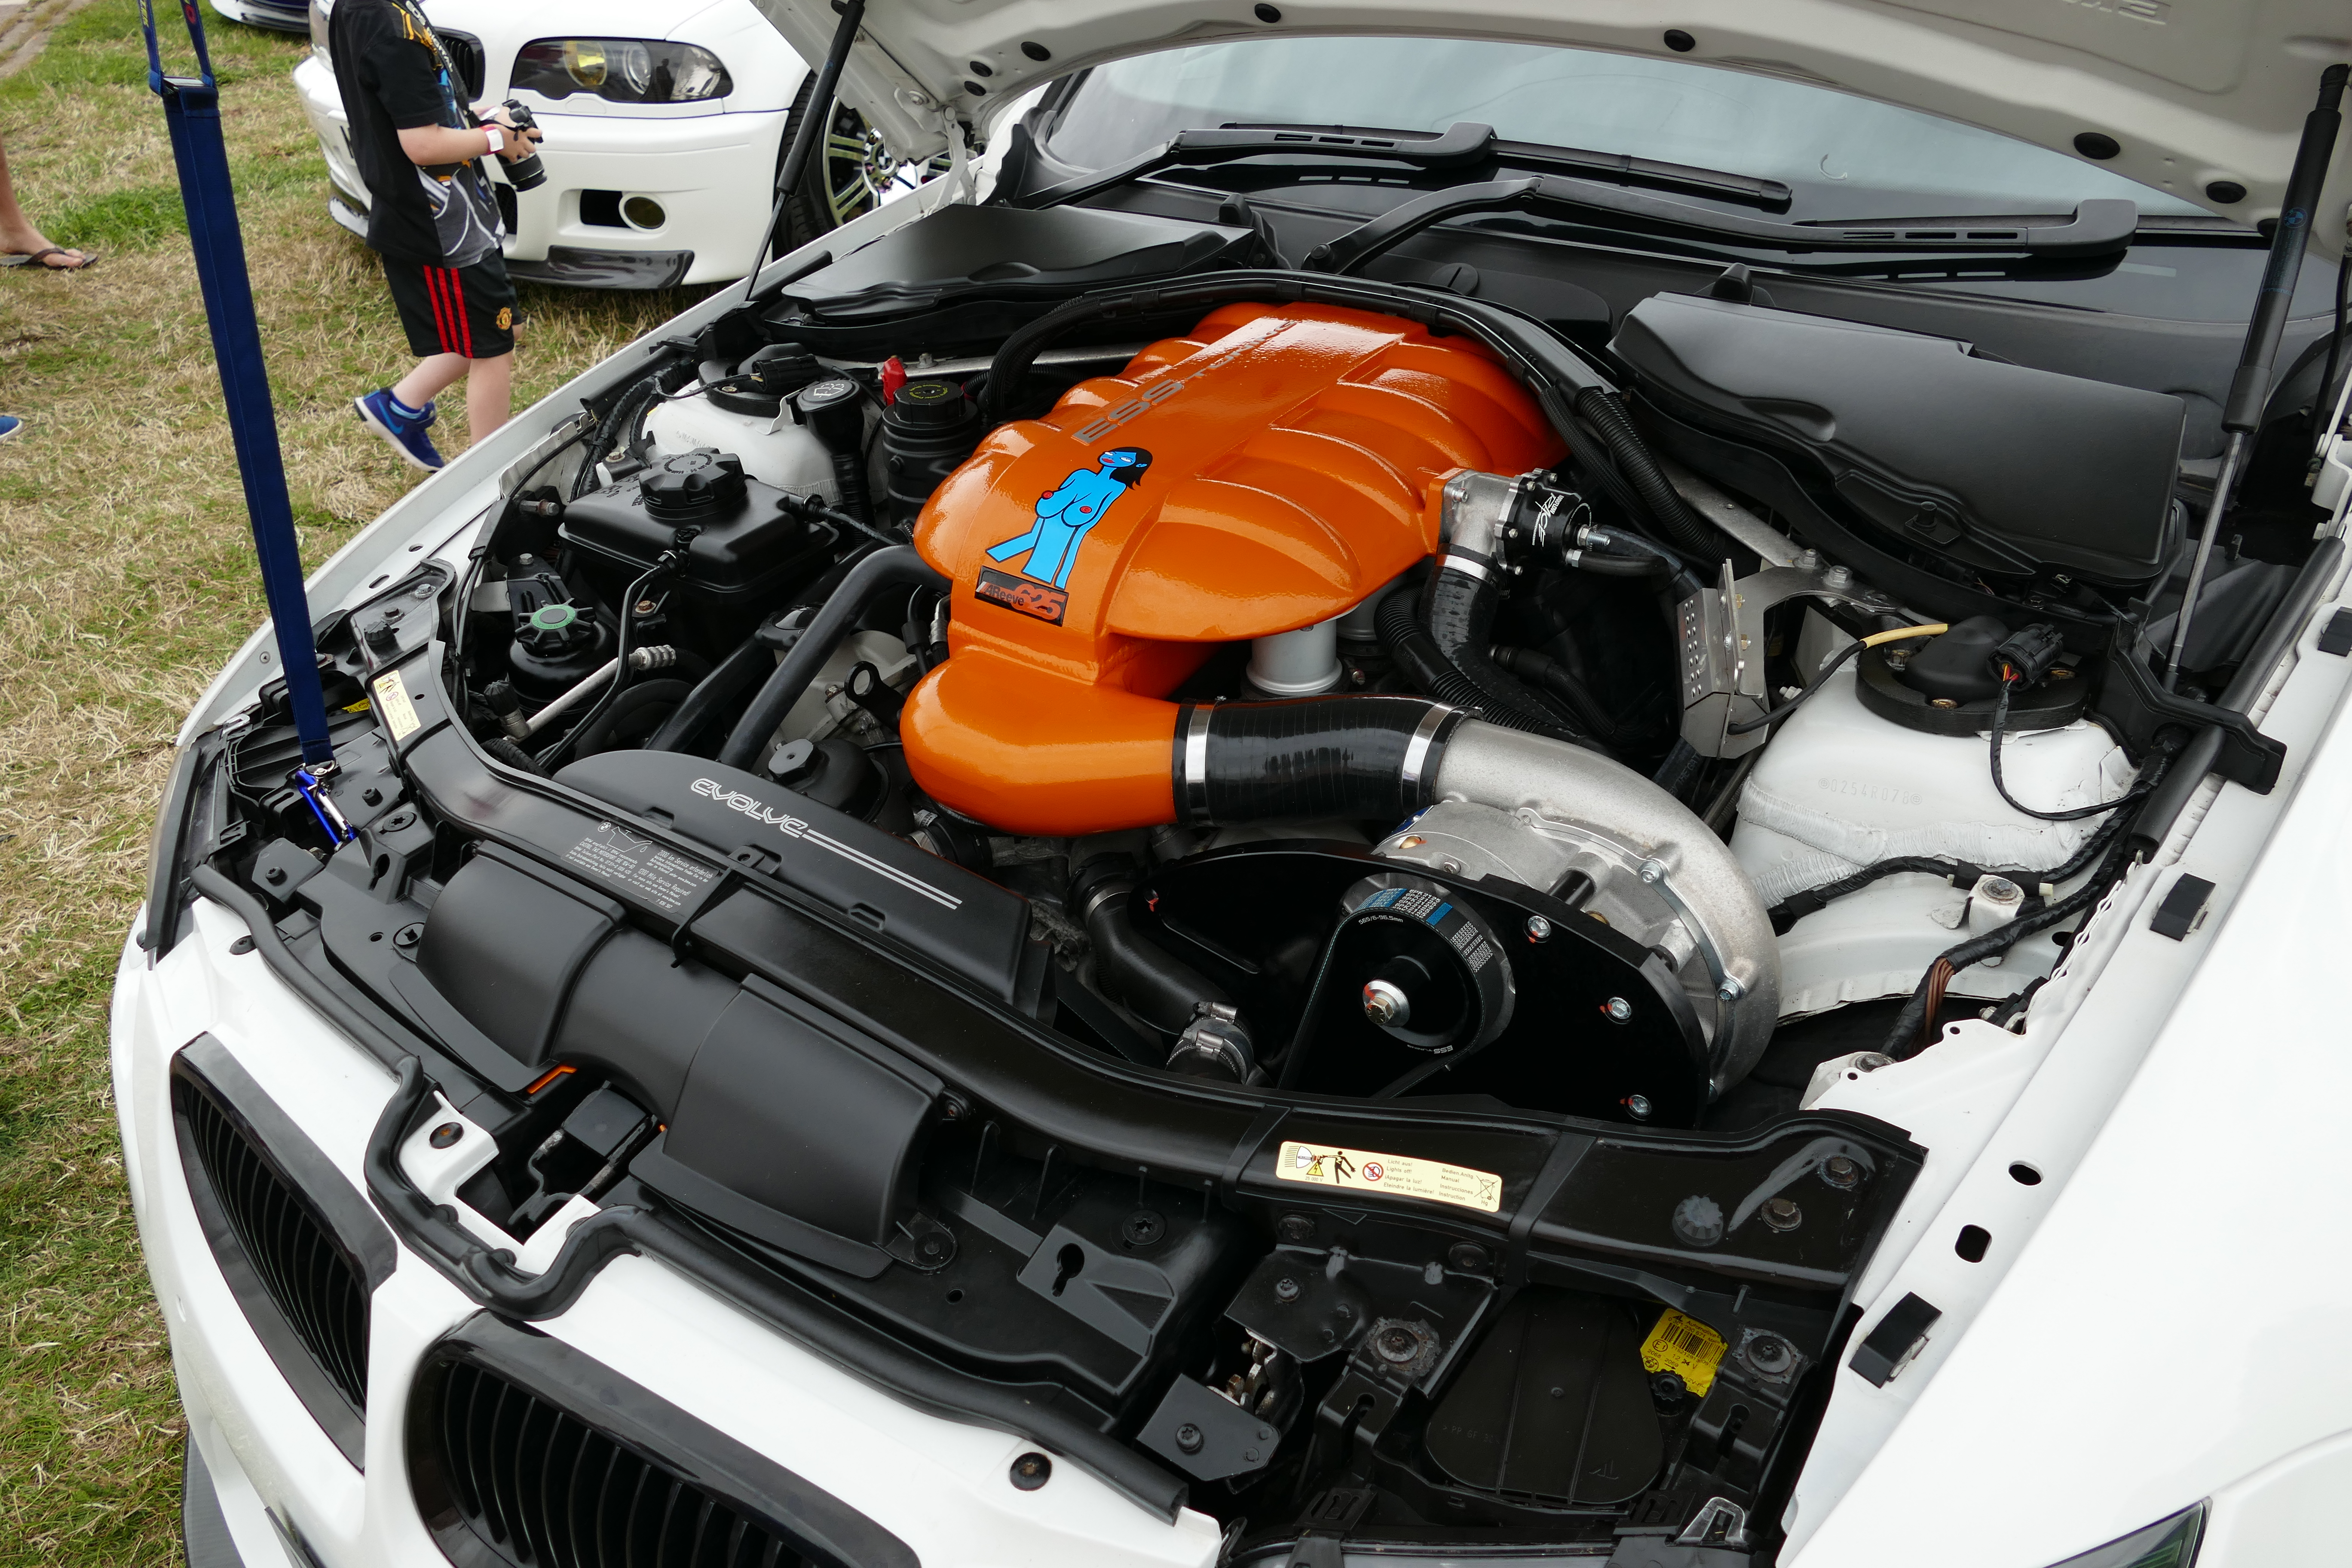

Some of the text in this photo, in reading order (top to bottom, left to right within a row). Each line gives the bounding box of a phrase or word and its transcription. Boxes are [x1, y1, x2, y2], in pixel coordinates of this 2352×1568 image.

[406, 0, 426, 25] EOS
[1071, 379, 1184, 446] ESS
[1011, 583, 1066, 620] 625
[691, 778, 808, 838] EVOLVE
[579, 841, 593, 849] CASTROL
[657, 850, 670, 858] 2000
[674, 858, 690, 867] Service
[689, 864, 714, 878] erforderlich
[656, 877, 672, 887] Service
[670, 884, 691, 897] Required!
[1358, 915, 1403, 925] S65/6-96.5mm
[1413, 1186, 1434, 1194] lumière!
[1439, 1191, 1465, 1201] Instruction
[1440, 1184, 1473, 1194] Instrucciones
[1684, 1324, 1695, 1333] 230
[1687, 1320, 1716, 1338] Automotive
[1647, 1349, 1679, 1368] 2068 2069
